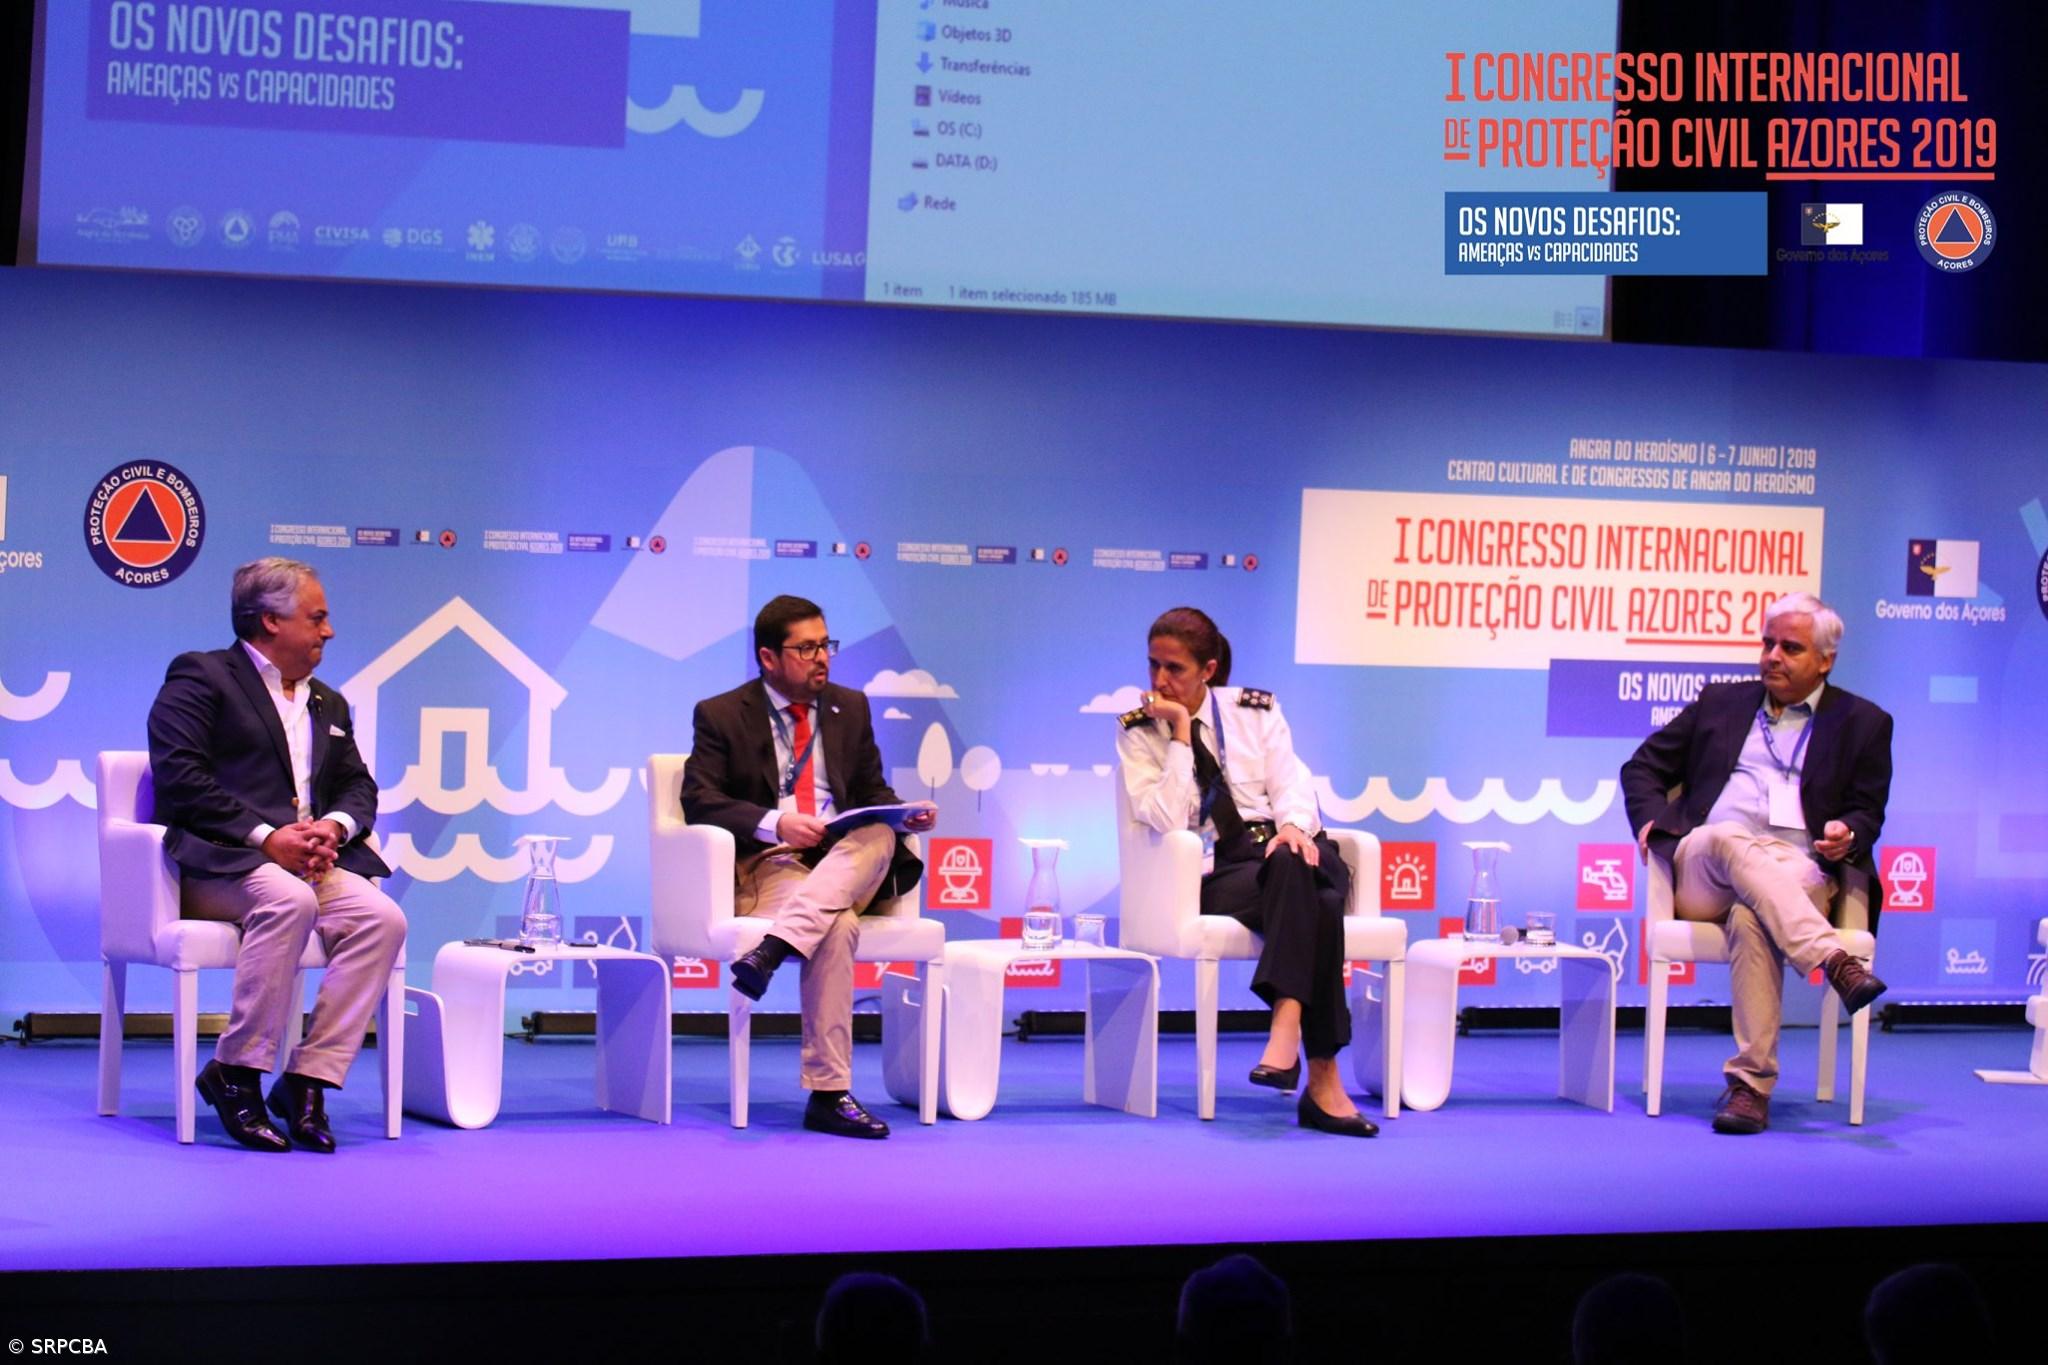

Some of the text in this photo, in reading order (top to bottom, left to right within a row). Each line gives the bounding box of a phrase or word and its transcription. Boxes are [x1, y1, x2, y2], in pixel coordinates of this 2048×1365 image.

[109, 1, 464, 70] OS NOVOS DESAFIOS:
[941, 25, 1012, 43] Objetos 3D
[940, 56, 1031, 76] Transferências
[106, 61, 211, 105] AMEAÇAS
[245, 69, 395, 110] CAPACIDADES
[937, 120, 982, 139] OS (C:)
[935, 153, 998, 171] DATA (D:)
[924, 195, 957, 211] Rede
[315, 226, 370, 241] CIVISA
[407, 228, 443, 245] DGS
[959, 286, 988, 300] item
[992, 288, 1067, 304] selecionado
[1570, 438, 1611, 461] ANGRA
[1614, 441, 1632, 461] DO
[1634, 438, 1696, 465] HEROÍSMO
[1707, 445, 1716, 465] 6
[1728, 446, 1736, 466] 7
[1738, 446, 1777, 467] JUNHO
[1787, 448, 1816, 469] 2019
[1448, 460, 1815, 495] CENTRO CULTURAL E DE CONGRESSOS DE ANGRA DO HEROÍSMO
[89, 466, 200, 548] PROTEÇÃO CIVIL E BOMBEIROS
[1394, 517, 1809, 577] I CONGRESSO INTERNACIONAL
[0, 549, 43, 575] çores
[115, 567, 169, 584] AÇORES
[1367, 579, 1388, 609] DE
[1394, 576, 1540, 640] PROTEÇÃO
[1551, 585, 1618, 632] CIVIL
[1626, 587, 1732, 635] AZORES
[1875, 599, 2006, 626] Governo dos Açores
[1618, 672, 1705, 702] OS NOVOS
